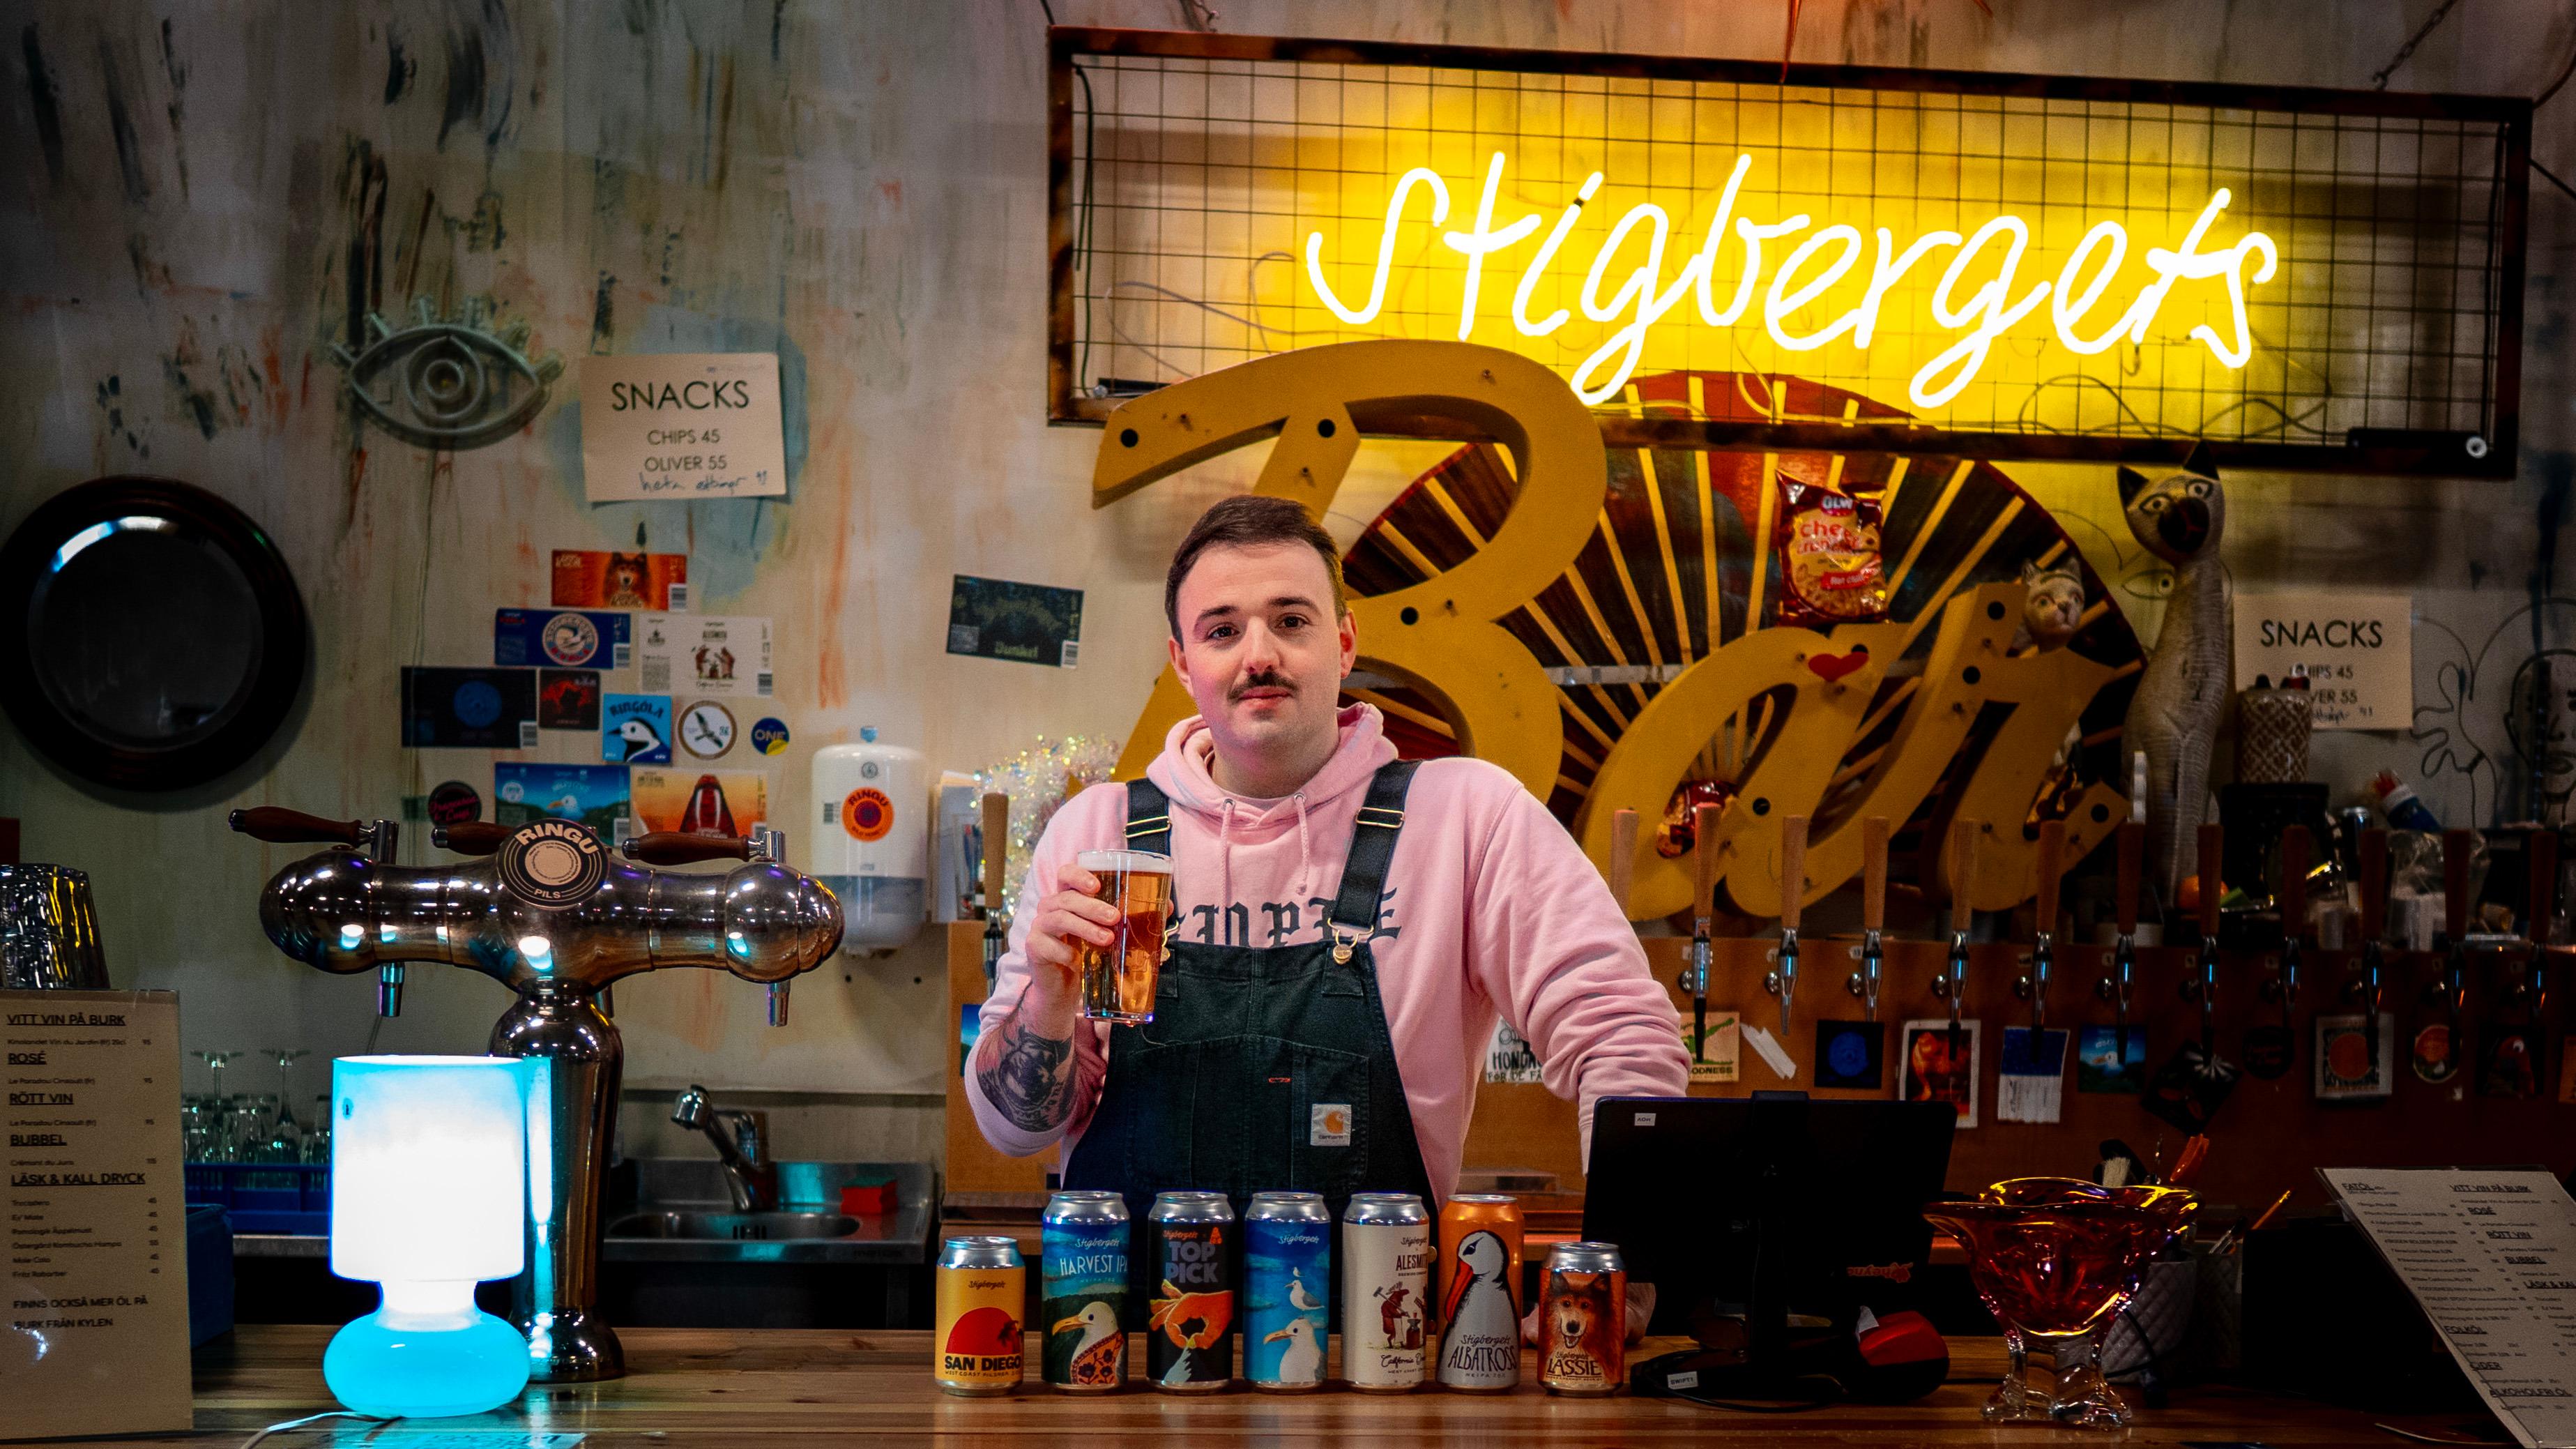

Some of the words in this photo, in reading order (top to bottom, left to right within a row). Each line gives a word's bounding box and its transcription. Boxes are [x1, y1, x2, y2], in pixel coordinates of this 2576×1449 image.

[1305, 151, 2278, 408] Stigbergets
[611, 380, 749, 411] SNACKS
[647, 430, 696, 445] CHIPS
[701, 429, 720, 443] 45
[645, 456, 702, 472] OLIVER
[708, 455, 727, 470] 55
[1092, 339, 2128, 920] Bar
[2260, 620, 2382, 648] SNACKS
[2290, 665, 2332, 680] HIPS
[2337, 665, 2354, 680] 45
[2310, 690, 2335, 704] VER
[2341, 689, 2358, 704] 55
[514, 823, 599, 854] RINGU
[534, 888, 561, 899] PILS
[8, 1015, 37, 1024] VITT
[41, 1015, 65, 1024] VIN
[70, 1012, 86, 1024] PÅ
[91, 1015, 125, 1025] BURK
[8, 1051, 46, 1063] ROSÉ
[10, 1091, 45, 1103] RÖTT
[49, 1093, 73, 1103] VIN
[10, 1135, 66, 1144] BUBBEL
[11, 1172, 47, 1184] LÄSK
[50, 1174, 59, 1183] &
[63, 1174, 98, 1183] KALL
[101, 1173, 145, 1183] DRYCK
[2490, 1183, 2505, 1192] PÅ
[2467, 1206, 2496, 1215] ROSÉ
[2487, 1230, 2513, 1238] RÖTT
[1168, 1241, 1216, 1262] TOP
[1060, 1254, 1113, 1276] HARVEST
[1165, 1262, 1219, 1284] PICK
[13, 1300, 47, 1308] FINNS
[52, 1298, 88, 1307] OCKSÅ
[91, 1298, 114, 1307] MER
[116, 1297, 131, 1306] ÖL
[134, 1295, 148, 1305] PÅ
[47, 1317, 75, 1327] FRÅN
[77, 1318, 113, 1326] KYLEN
[2445, 1325, 2487, 1333] FOLKÖL
[1461, 1334, 1511, 1347] Stigbergets
[945, 1356, 975, 1370] SAN
[982, 1356, 1021, 1371] DIEGO
[1447, 1345, 1518, 1372] ALBATROSS
[1546, 1358, 1602, 1376] LASSIE
